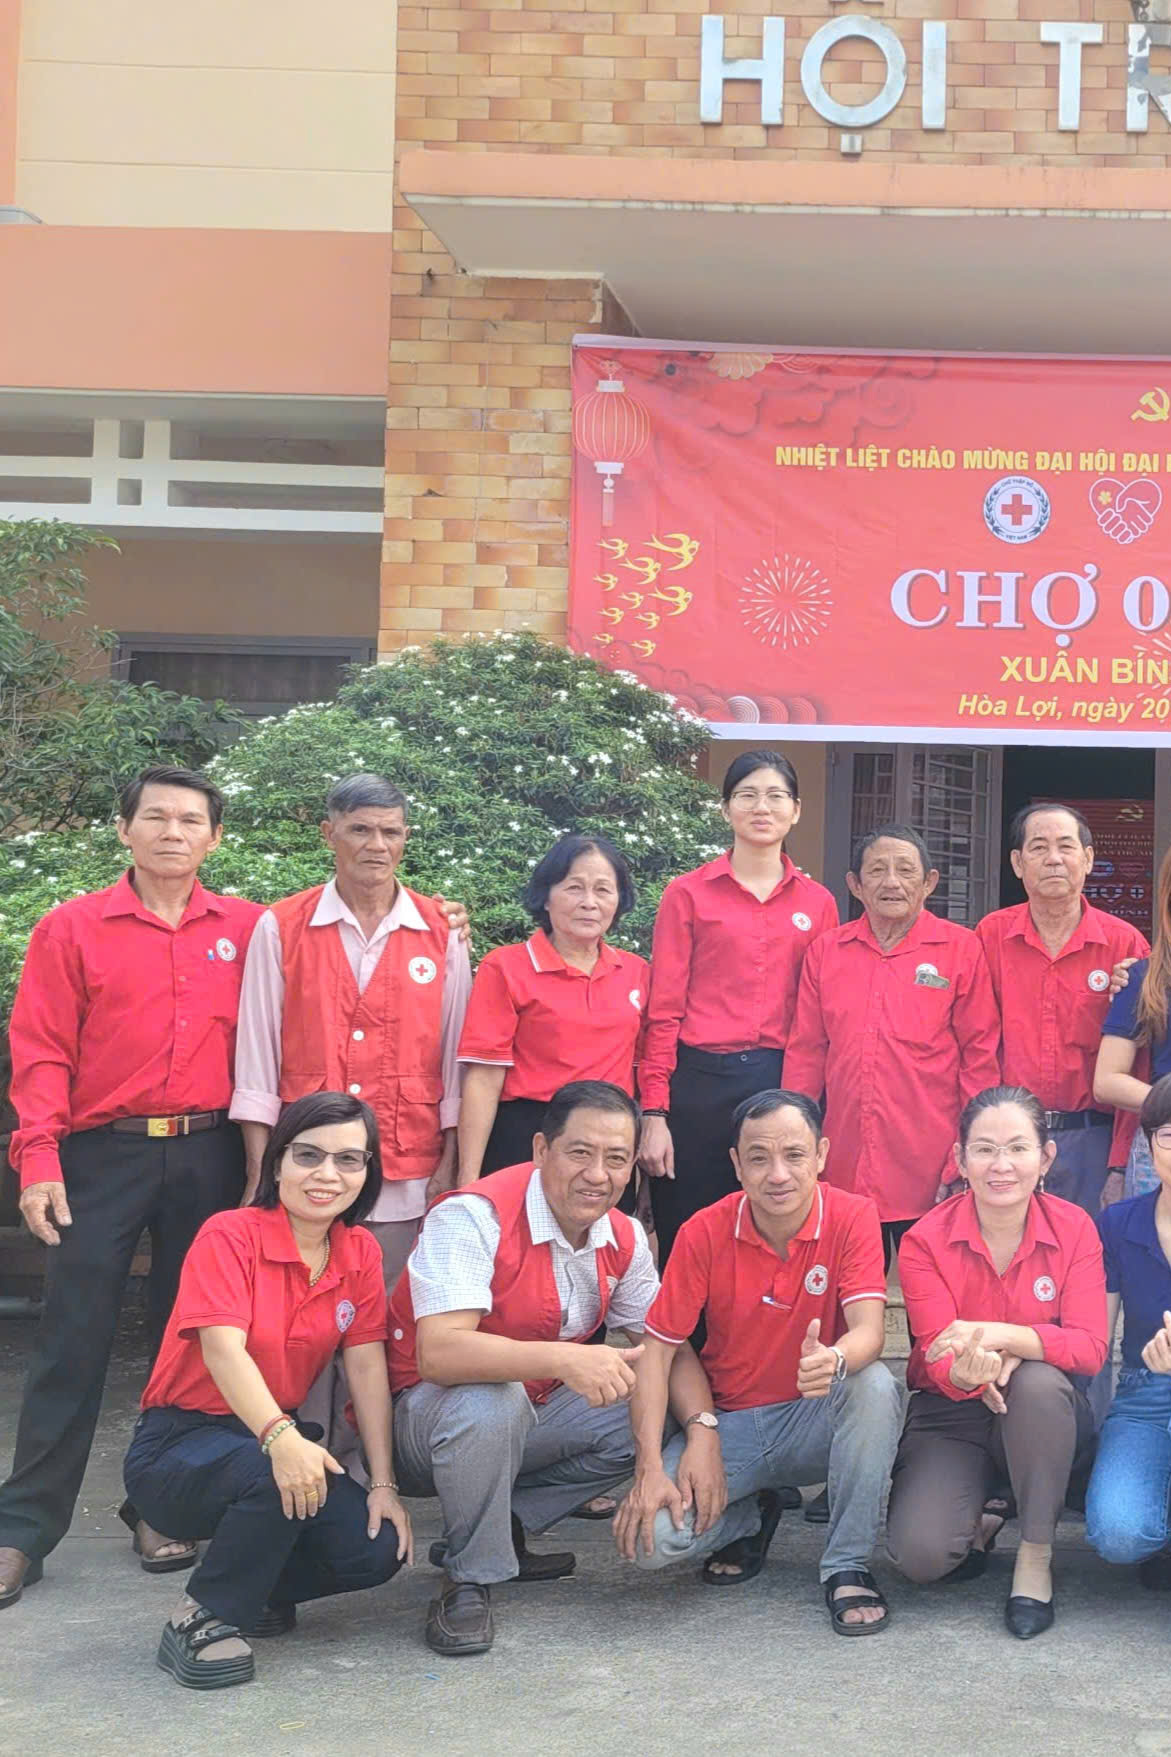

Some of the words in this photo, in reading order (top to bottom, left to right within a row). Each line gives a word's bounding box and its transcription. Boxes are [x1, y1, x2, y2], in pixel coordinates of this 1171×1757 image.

[775, 444, 839, 471] NHIỆT
[846, 444, 890, 472] LIỆT
[897, 445, 956, 470] CHÀO
[963, 446, 1029, 471] MỪNG
[1036, 451, 1072, 475] ĐẠI
[1080, 448, 1116, 476] HỘI
[1122, 452, 1160, 477] ĐẠI
[890, 563, 1098, 648] CHỢ
[1123, 575, 1170, 631] 0
[1000, 650, 1099, 684] XUÂN
[958, 693, 1008, 716] Hòa
[1016, 695, 1062, 721] Lợi,
[1071, 699, 1133, 724] ngày
[1141, 697, 1171, 719] 20
